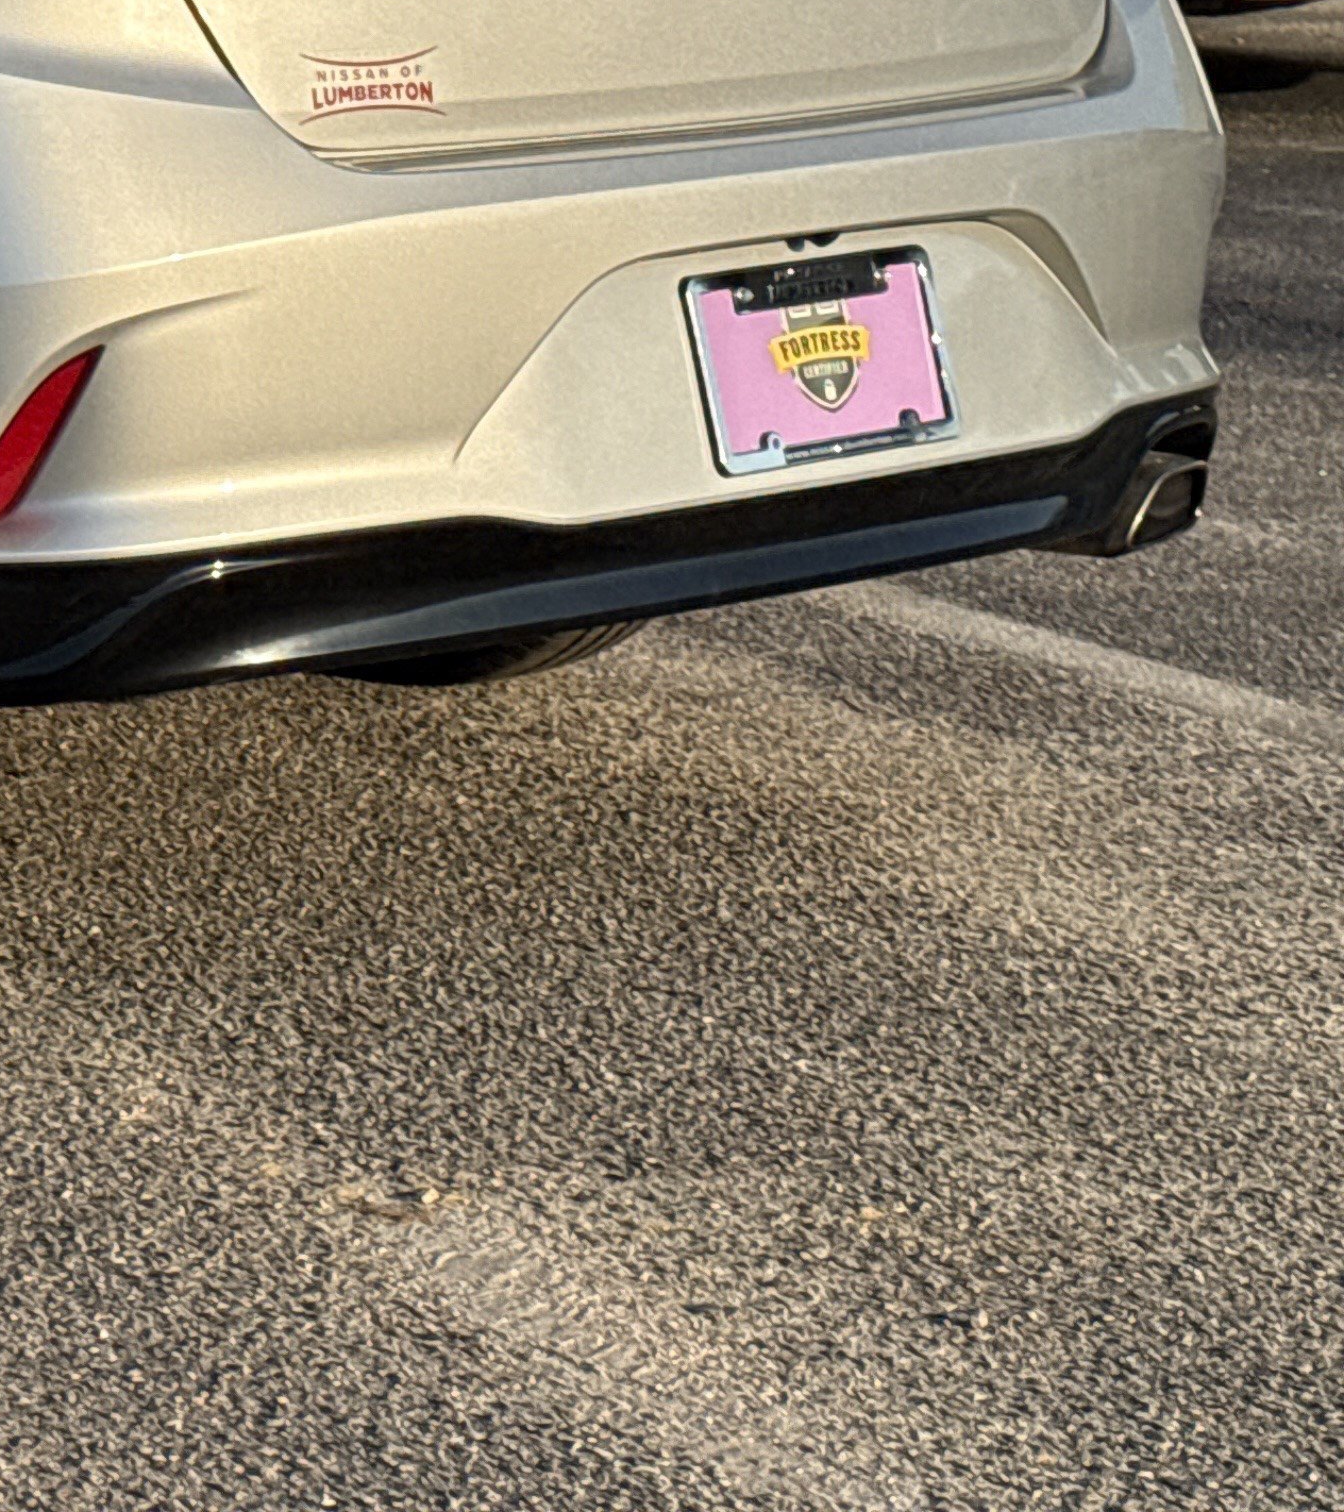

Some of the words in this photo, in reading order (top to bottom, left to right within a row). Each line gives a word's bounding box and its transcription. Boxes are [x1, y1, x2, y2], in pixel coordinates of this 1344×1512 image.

[316, 68, 389, 82] NISSAN
[400, 65, 423, 78] OF
[311, 81, 434, 110] LUMBERTON
[778, 330, 862, 362] FORTRESS
